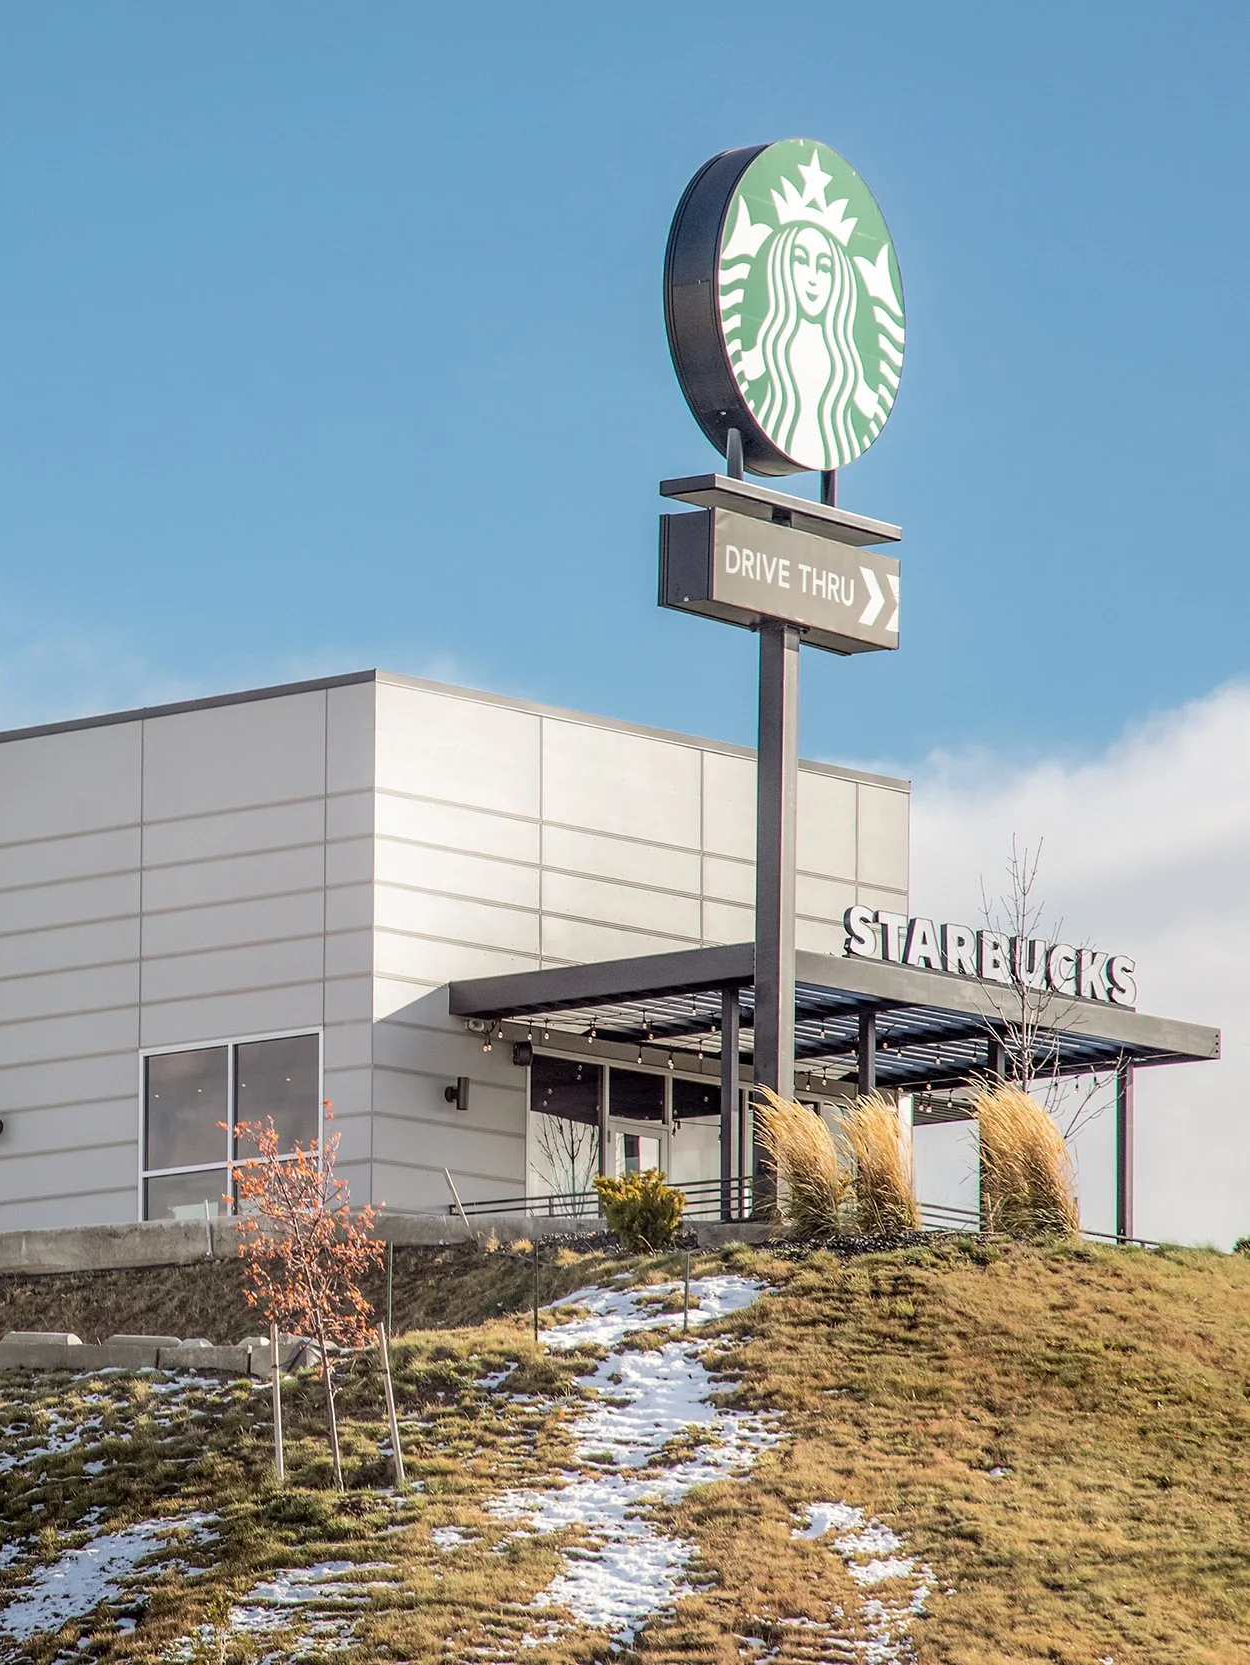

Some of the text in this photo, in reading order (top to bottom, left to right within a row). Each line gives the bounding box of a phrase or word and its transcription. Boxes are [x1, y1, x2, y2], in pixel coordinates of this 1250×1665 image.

[725, 544, 855, 606] DRIVE THRU
[844, 904, 1137, 1006] STARBUCKS
